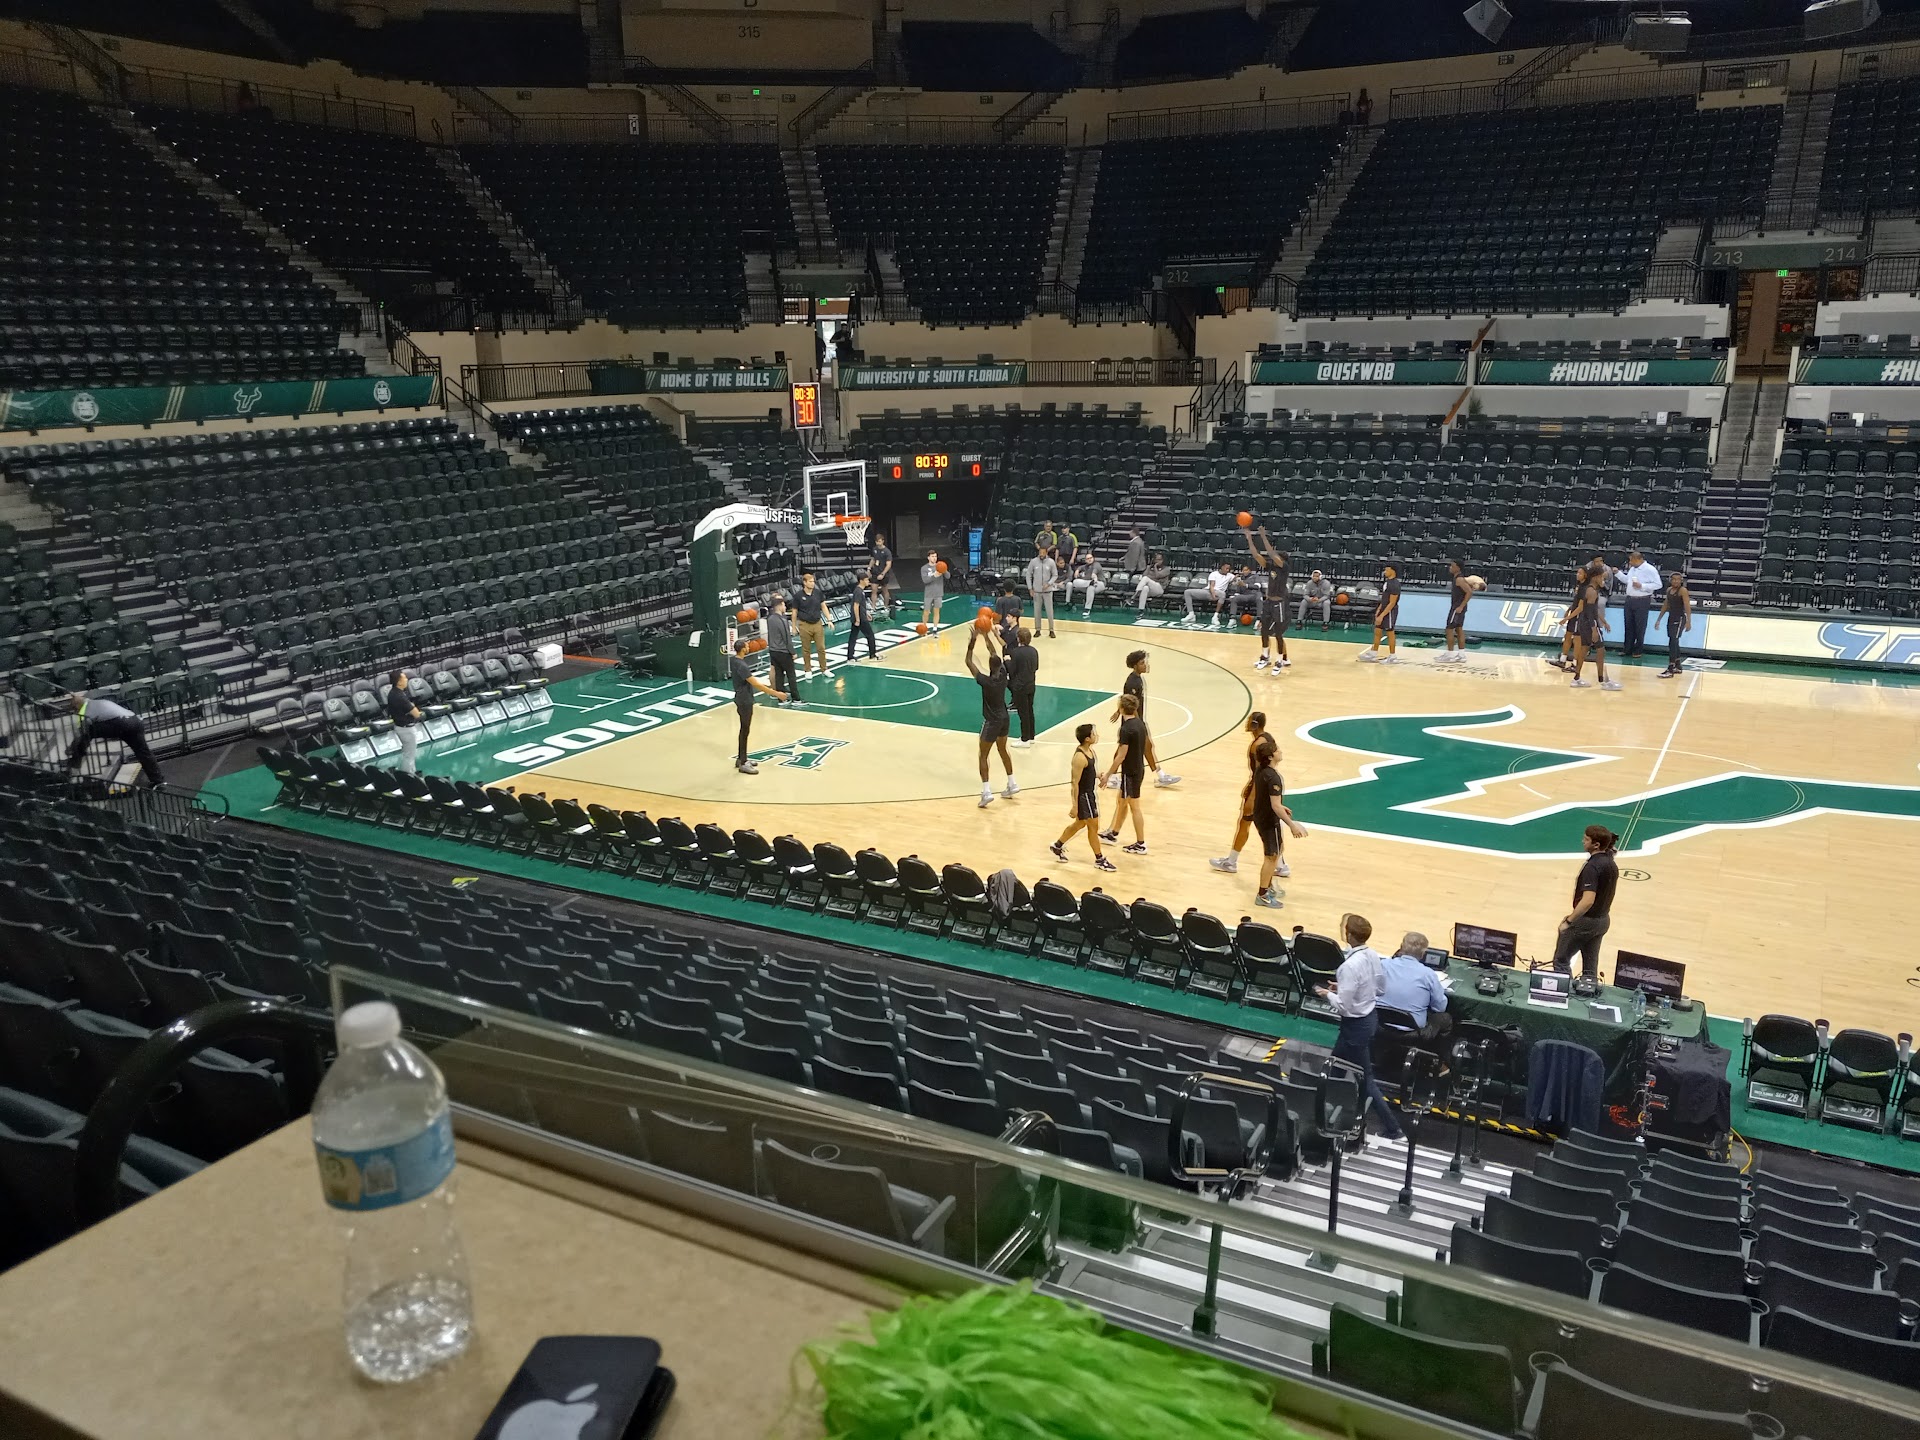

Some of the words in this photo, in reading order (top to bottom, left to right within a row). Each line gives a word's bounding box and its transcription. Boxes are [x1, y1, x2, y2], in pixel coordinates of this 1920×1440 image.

[738, 26, 761, 38] 315
[1712, 251, 1743, 265] 213
[1824, 247, 1856, 261] 214
[1167, 270, 1189, 283] 212
[856, 370, 915, 384] UNIVERSITY
[918, 370, 931, 383] OF
[933, 369, 965, 383] SOUTH
[968, 368, 1009, 382] FLORIDA
[1317, 362, 1396, 381] @USFWBB
[1549, 361, 1649, 382] #HORNSUP
[660, 373, 692, 388] HOME
[695, 373, 709, 387] OF
[712, 373, 733, 387] THE
[735, 372, 770, 387] BULLS
[795, 387, 815, 401] 80:30
[797, 401, 814, 423] 30
[882, 456, 901, 464] HOME
[915, 455, 948, 468] 80:30
[961, 454, 982, 462] GUEST
[893, 466, 902, 479] 0
[971, 463, 981, 477] 0
[1702, 600, 1721, 608] POSS
[493, 686, 737, 768] SOUTH
[1787, 1093, 1799, 1102] 28
[1863, 1107, 1875, 1117] 27
